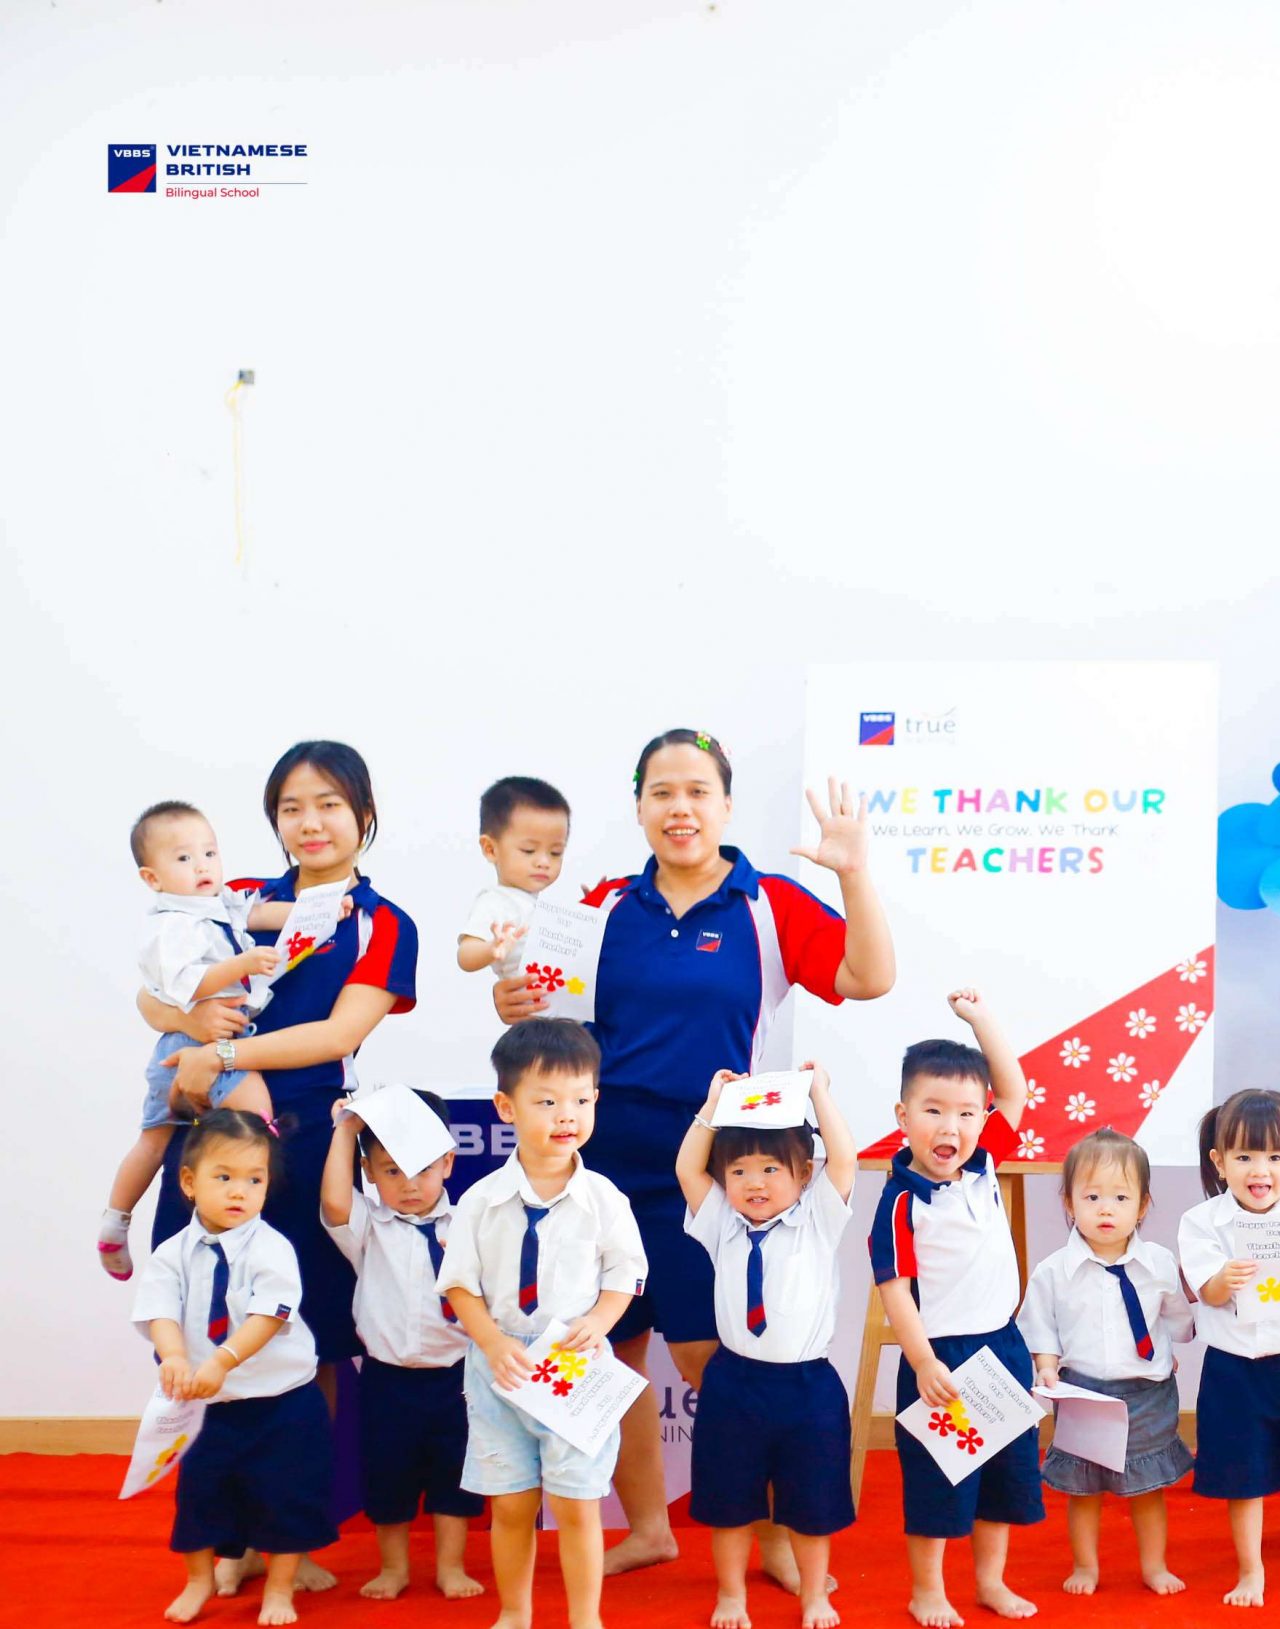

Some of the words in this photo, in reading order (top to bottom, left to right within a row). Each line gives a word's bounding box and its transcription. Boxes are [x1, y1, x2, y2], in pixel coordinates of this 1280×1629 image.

[933, 787, 1069, 816] THANK
[1083, 788, 1167, 815] OUR
[872, 824, 899, 837] We
[957, 824, 984, 837] We
[1039, 824, 1065, 837] We
[1072, 823, 1119, 837] Thank
[906, 846, 1105, 875] TEACHERS
[1236, 1219, 1267, 1230] Happy
[1247, 1241, 1280, 1251] Thank
[963, 1376, 991, 1406] Thank
